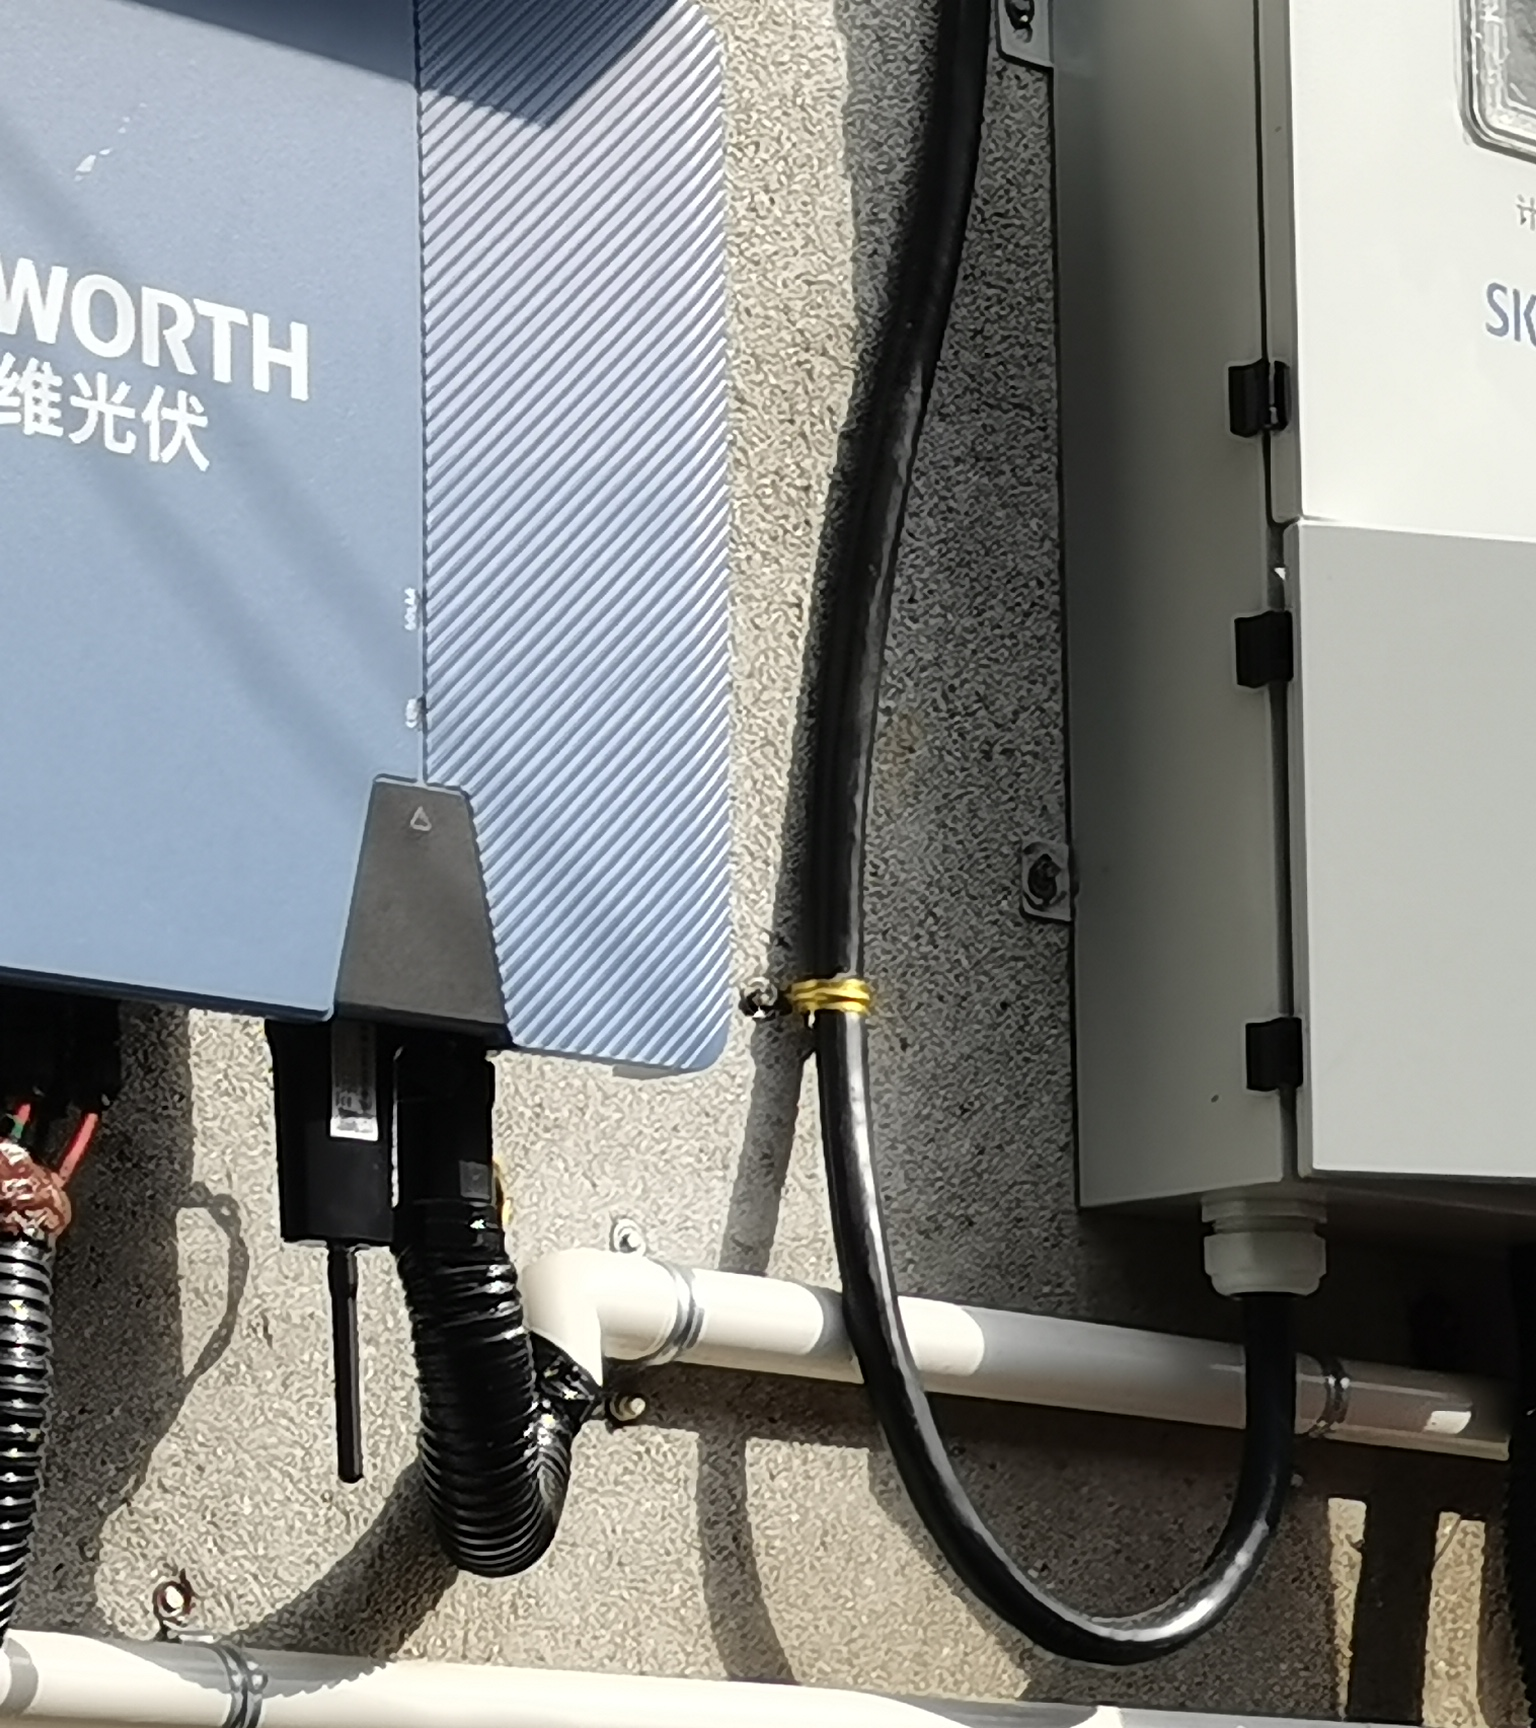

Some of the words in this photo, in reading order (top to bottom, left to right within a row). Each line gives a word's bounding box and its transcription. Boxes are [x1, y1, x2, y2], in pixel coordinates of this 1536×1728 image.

[0, 257, 309, 402] WORTH
[0, 352, 210, 472] 维光伏
